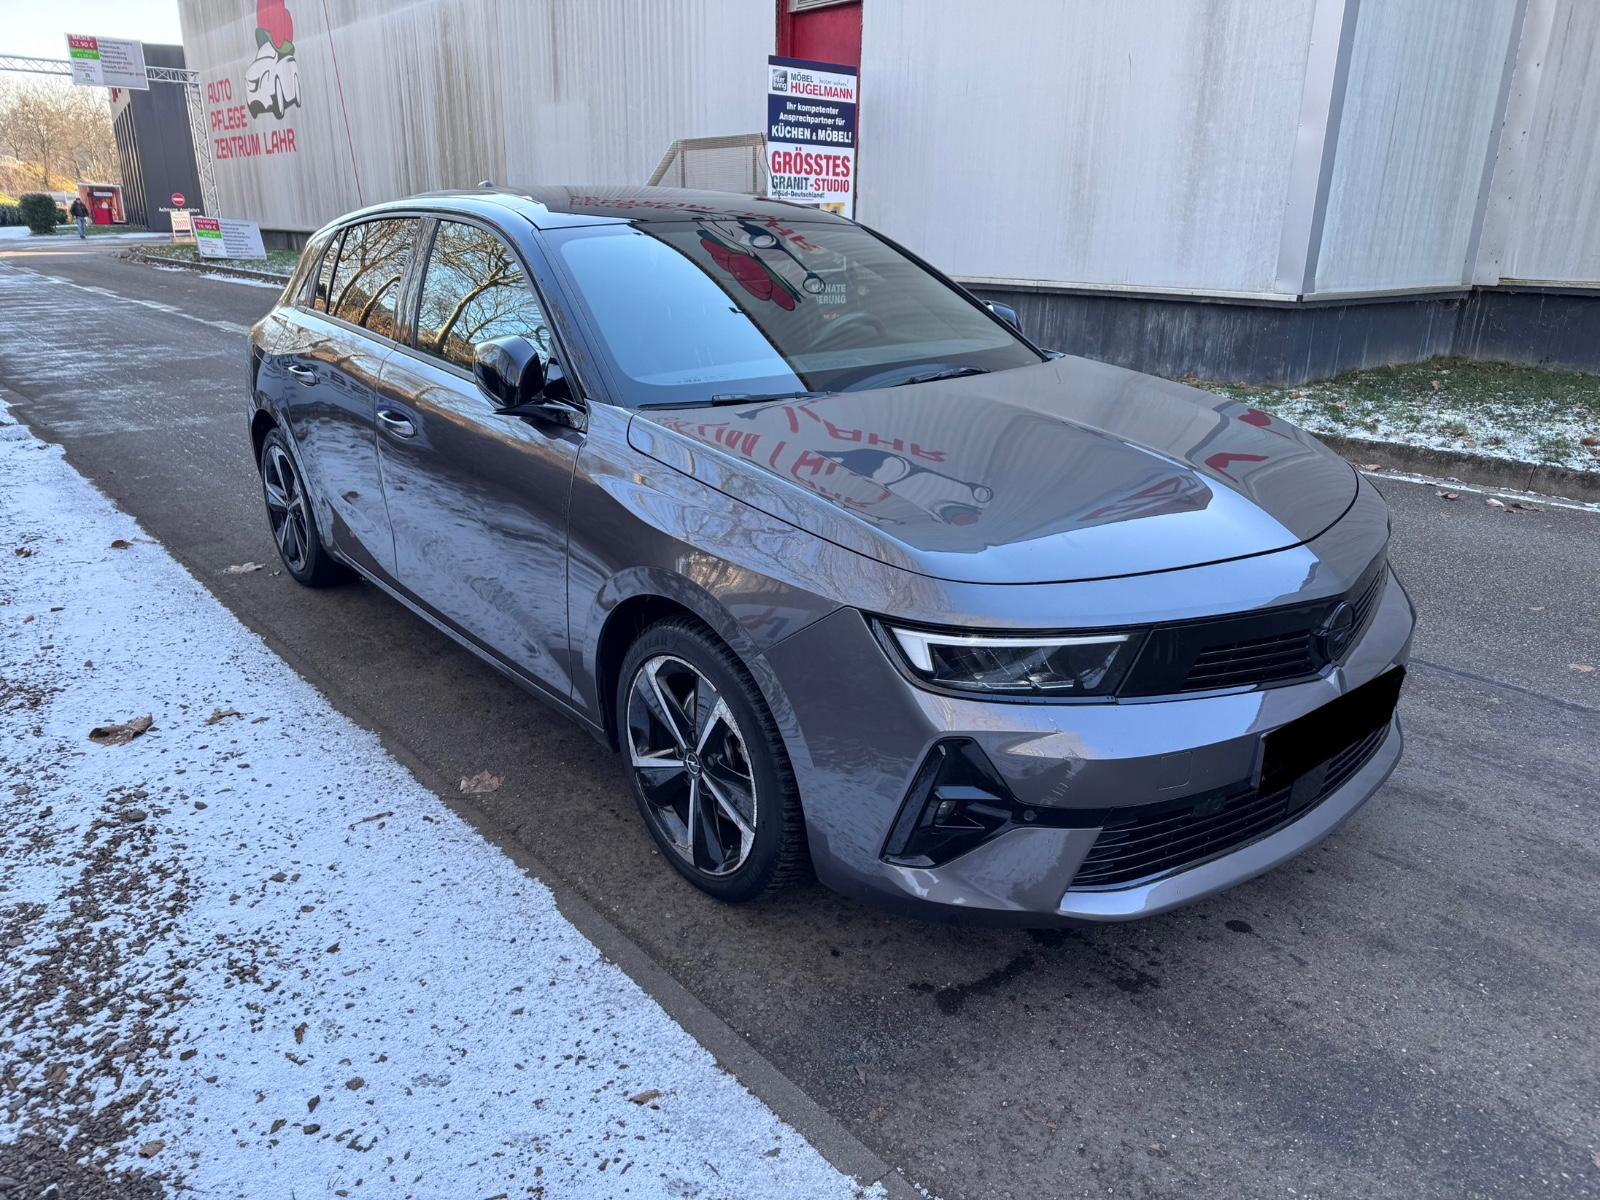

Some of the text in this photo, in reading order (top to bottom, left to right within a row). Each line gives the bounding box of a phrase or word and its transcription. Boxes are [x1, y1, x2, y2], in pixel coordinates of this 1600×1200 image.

[791, 72, 813, 82] MÖBEL
[208, 78, 232, 104] AUTO
[790, 82, 853, 99] HUGELMANN
[798, 103, 839, 115] kompetenter
[210, 105, 247, 132] PFLEGE
[779, 112, 834, 125] Ansprechpartner
[772, 123, 810, 139] KÜCHEN
[818, 128, 851, 143] MÖBEL!
[214, 128, 296, 159] ZENTRUM LAHR
[772, 147, 850, 177] GRÖSSTES
[772, 175, 849, 192] GRANIT-STUDIO
